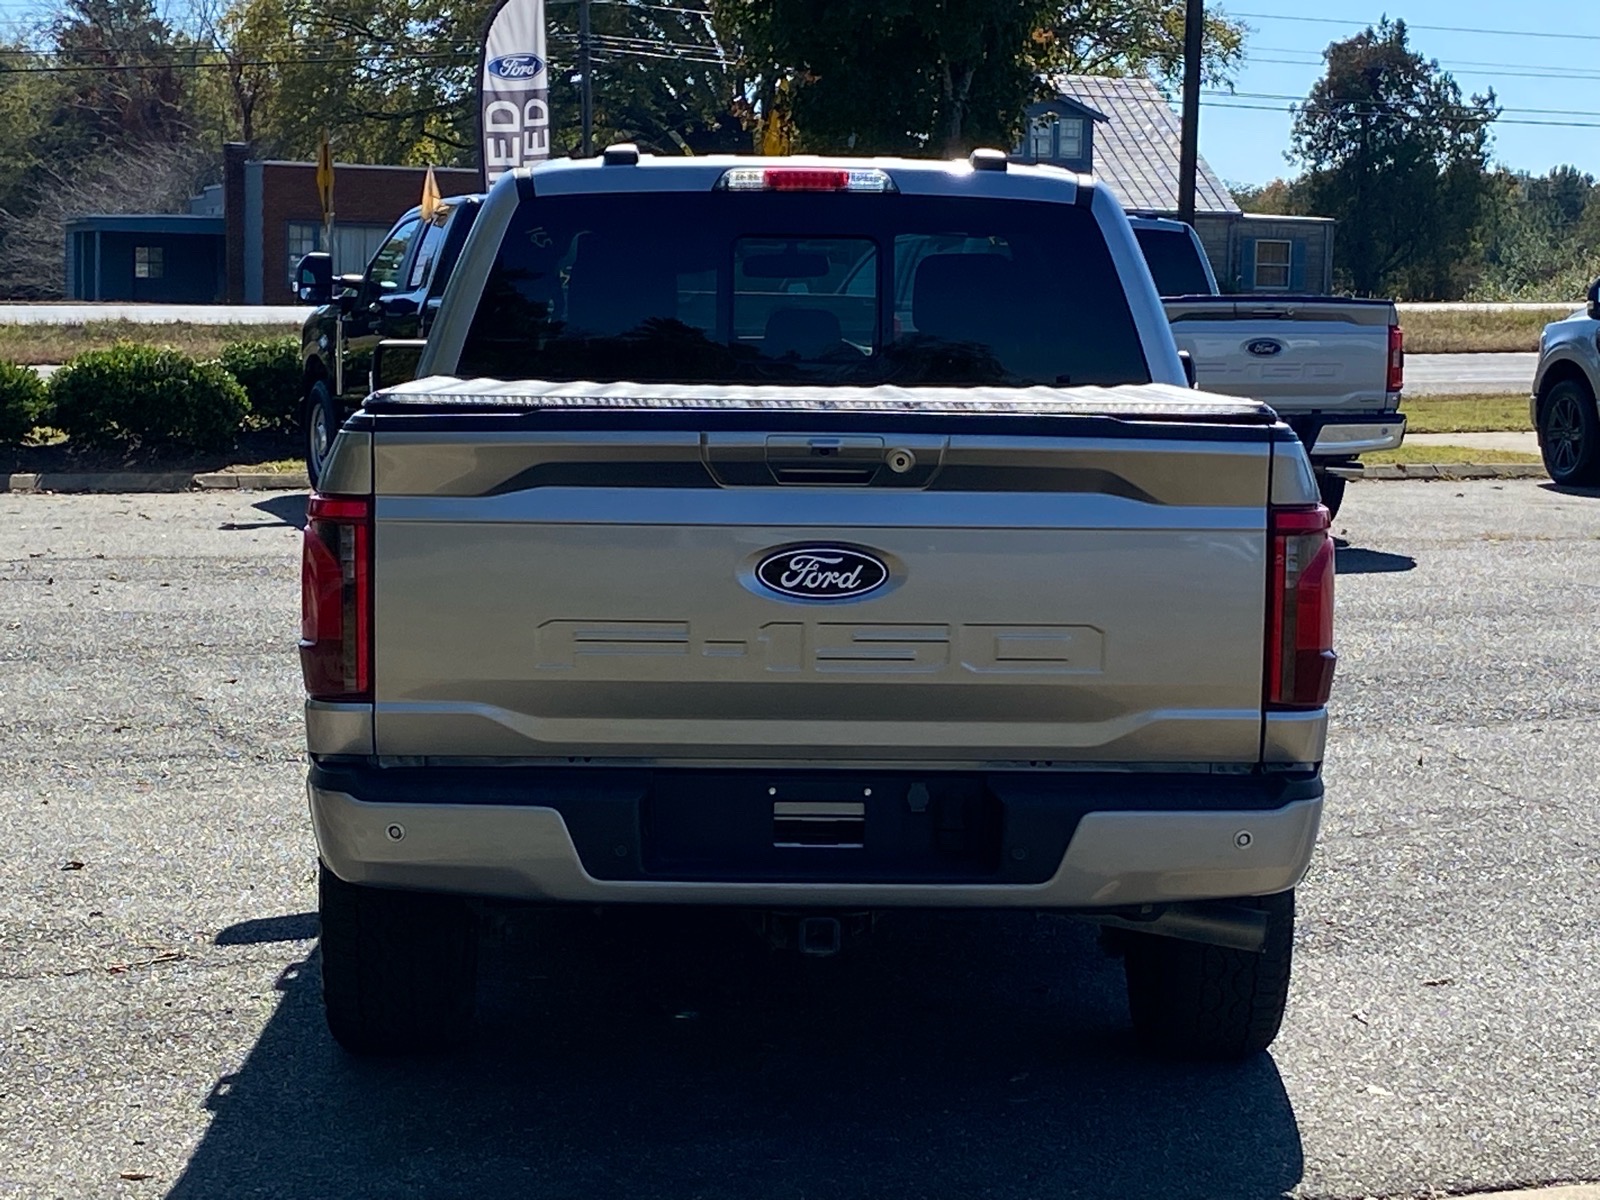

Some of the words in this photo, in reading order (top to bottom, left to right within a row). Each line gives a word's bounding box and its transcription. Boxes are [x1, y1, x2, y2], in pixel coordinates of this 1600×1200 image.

[499, 56, 536, 77] Ford
[485, 100, 521, 192] ED
[780, 555, 864, 589] Ford
[535, 619, 1106, 674] F-150
